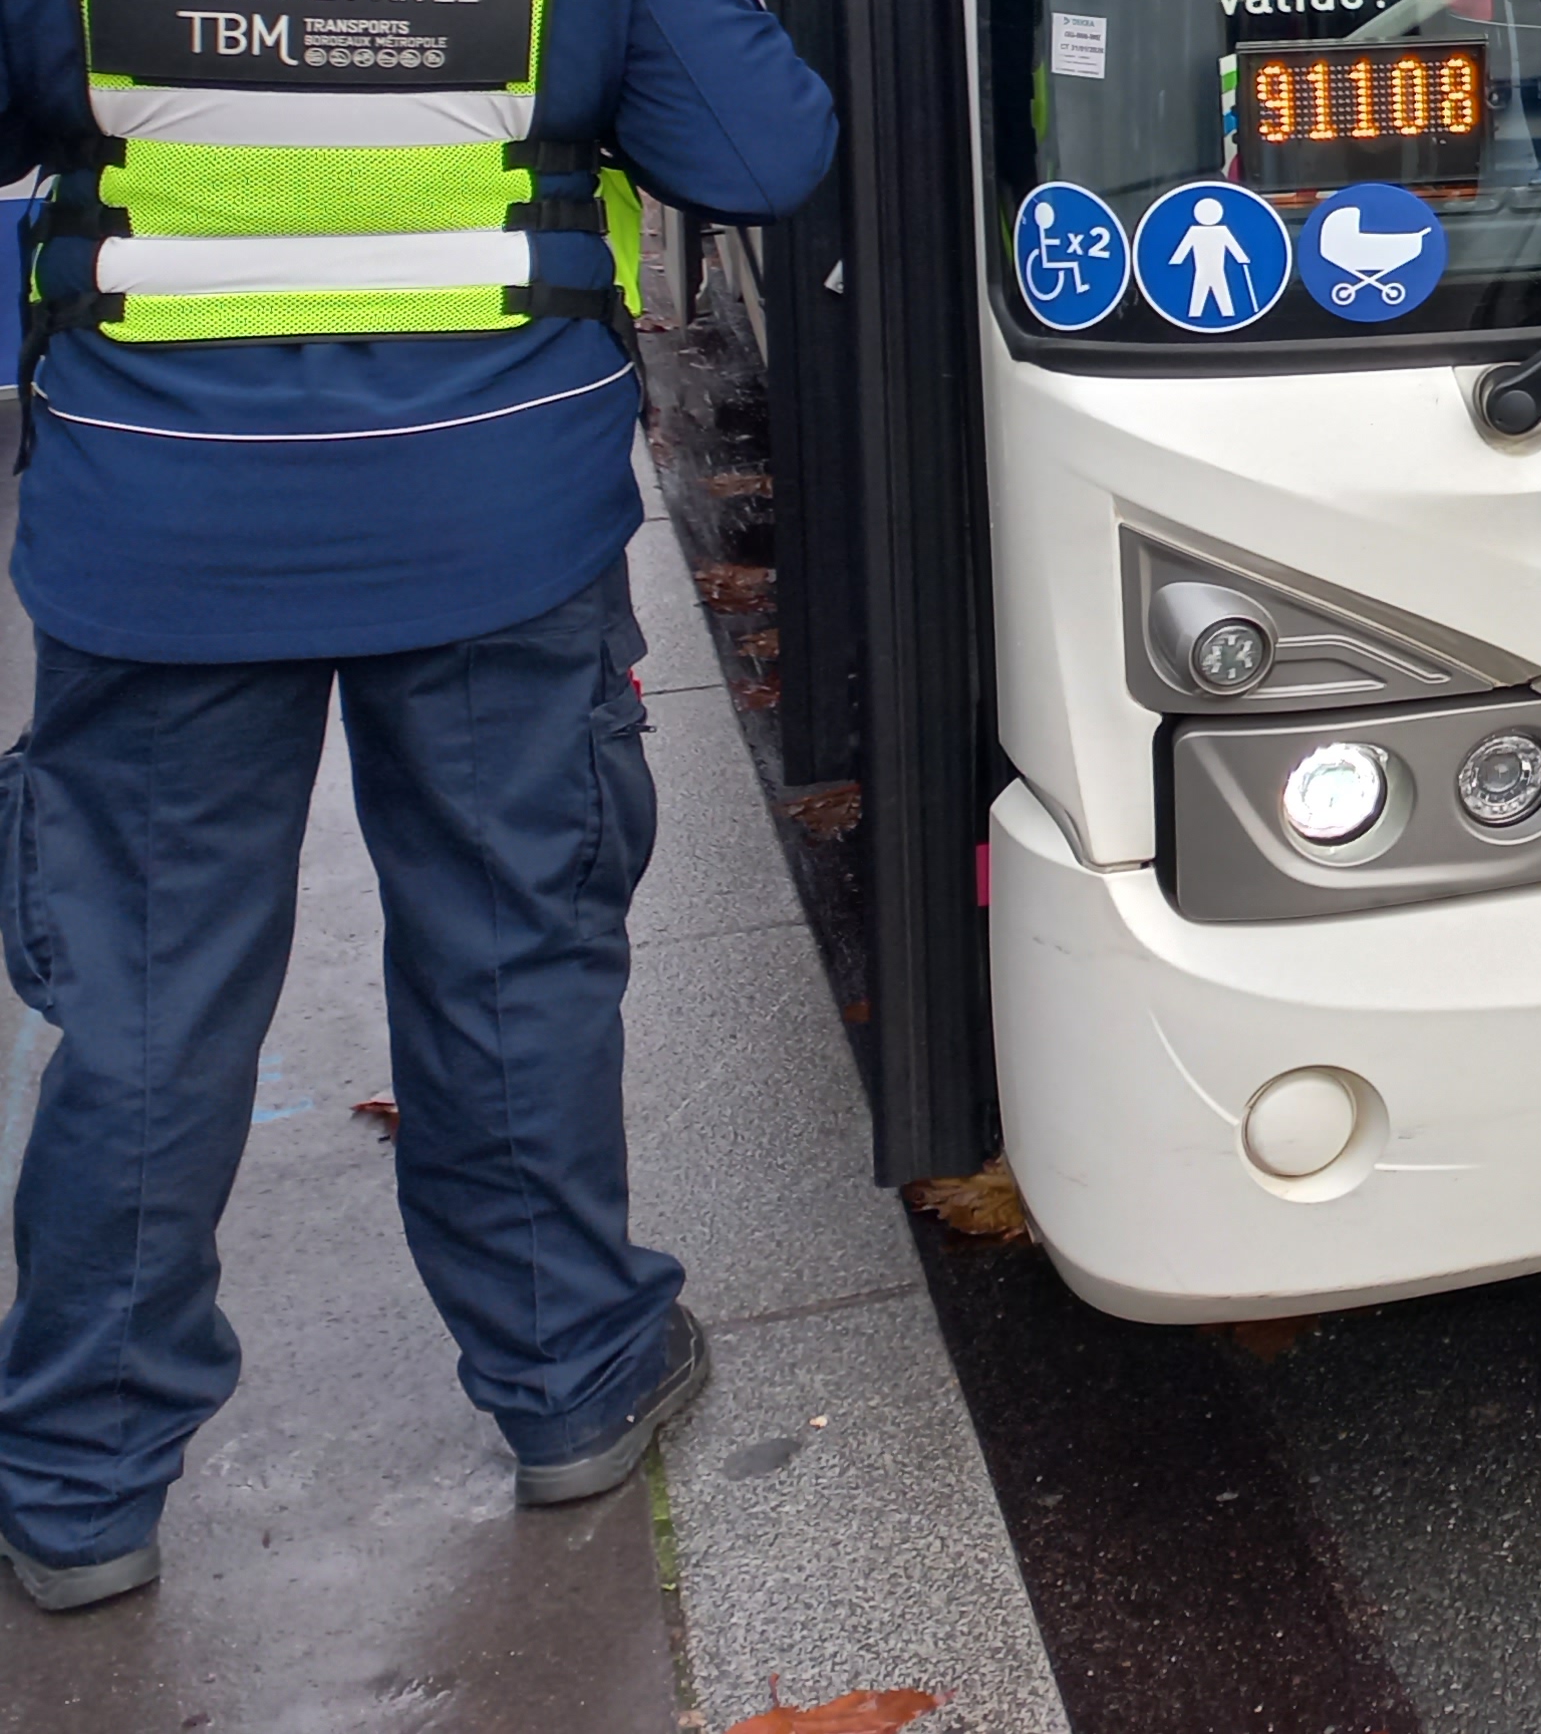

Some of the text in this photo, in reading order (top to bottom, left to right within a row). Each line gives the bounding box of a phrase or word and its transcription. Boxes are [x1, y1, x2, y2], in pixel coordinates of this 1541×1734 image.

[175, 10, 299, 66] TBM
[303, 18, 411, 34] TRANSPORTS
[303, 34, 448, 48] BORDEAUX MÉTROPOLE
[1256, 58, 1474, 142] 91108
[1066, 226, 1111, 259] x2
